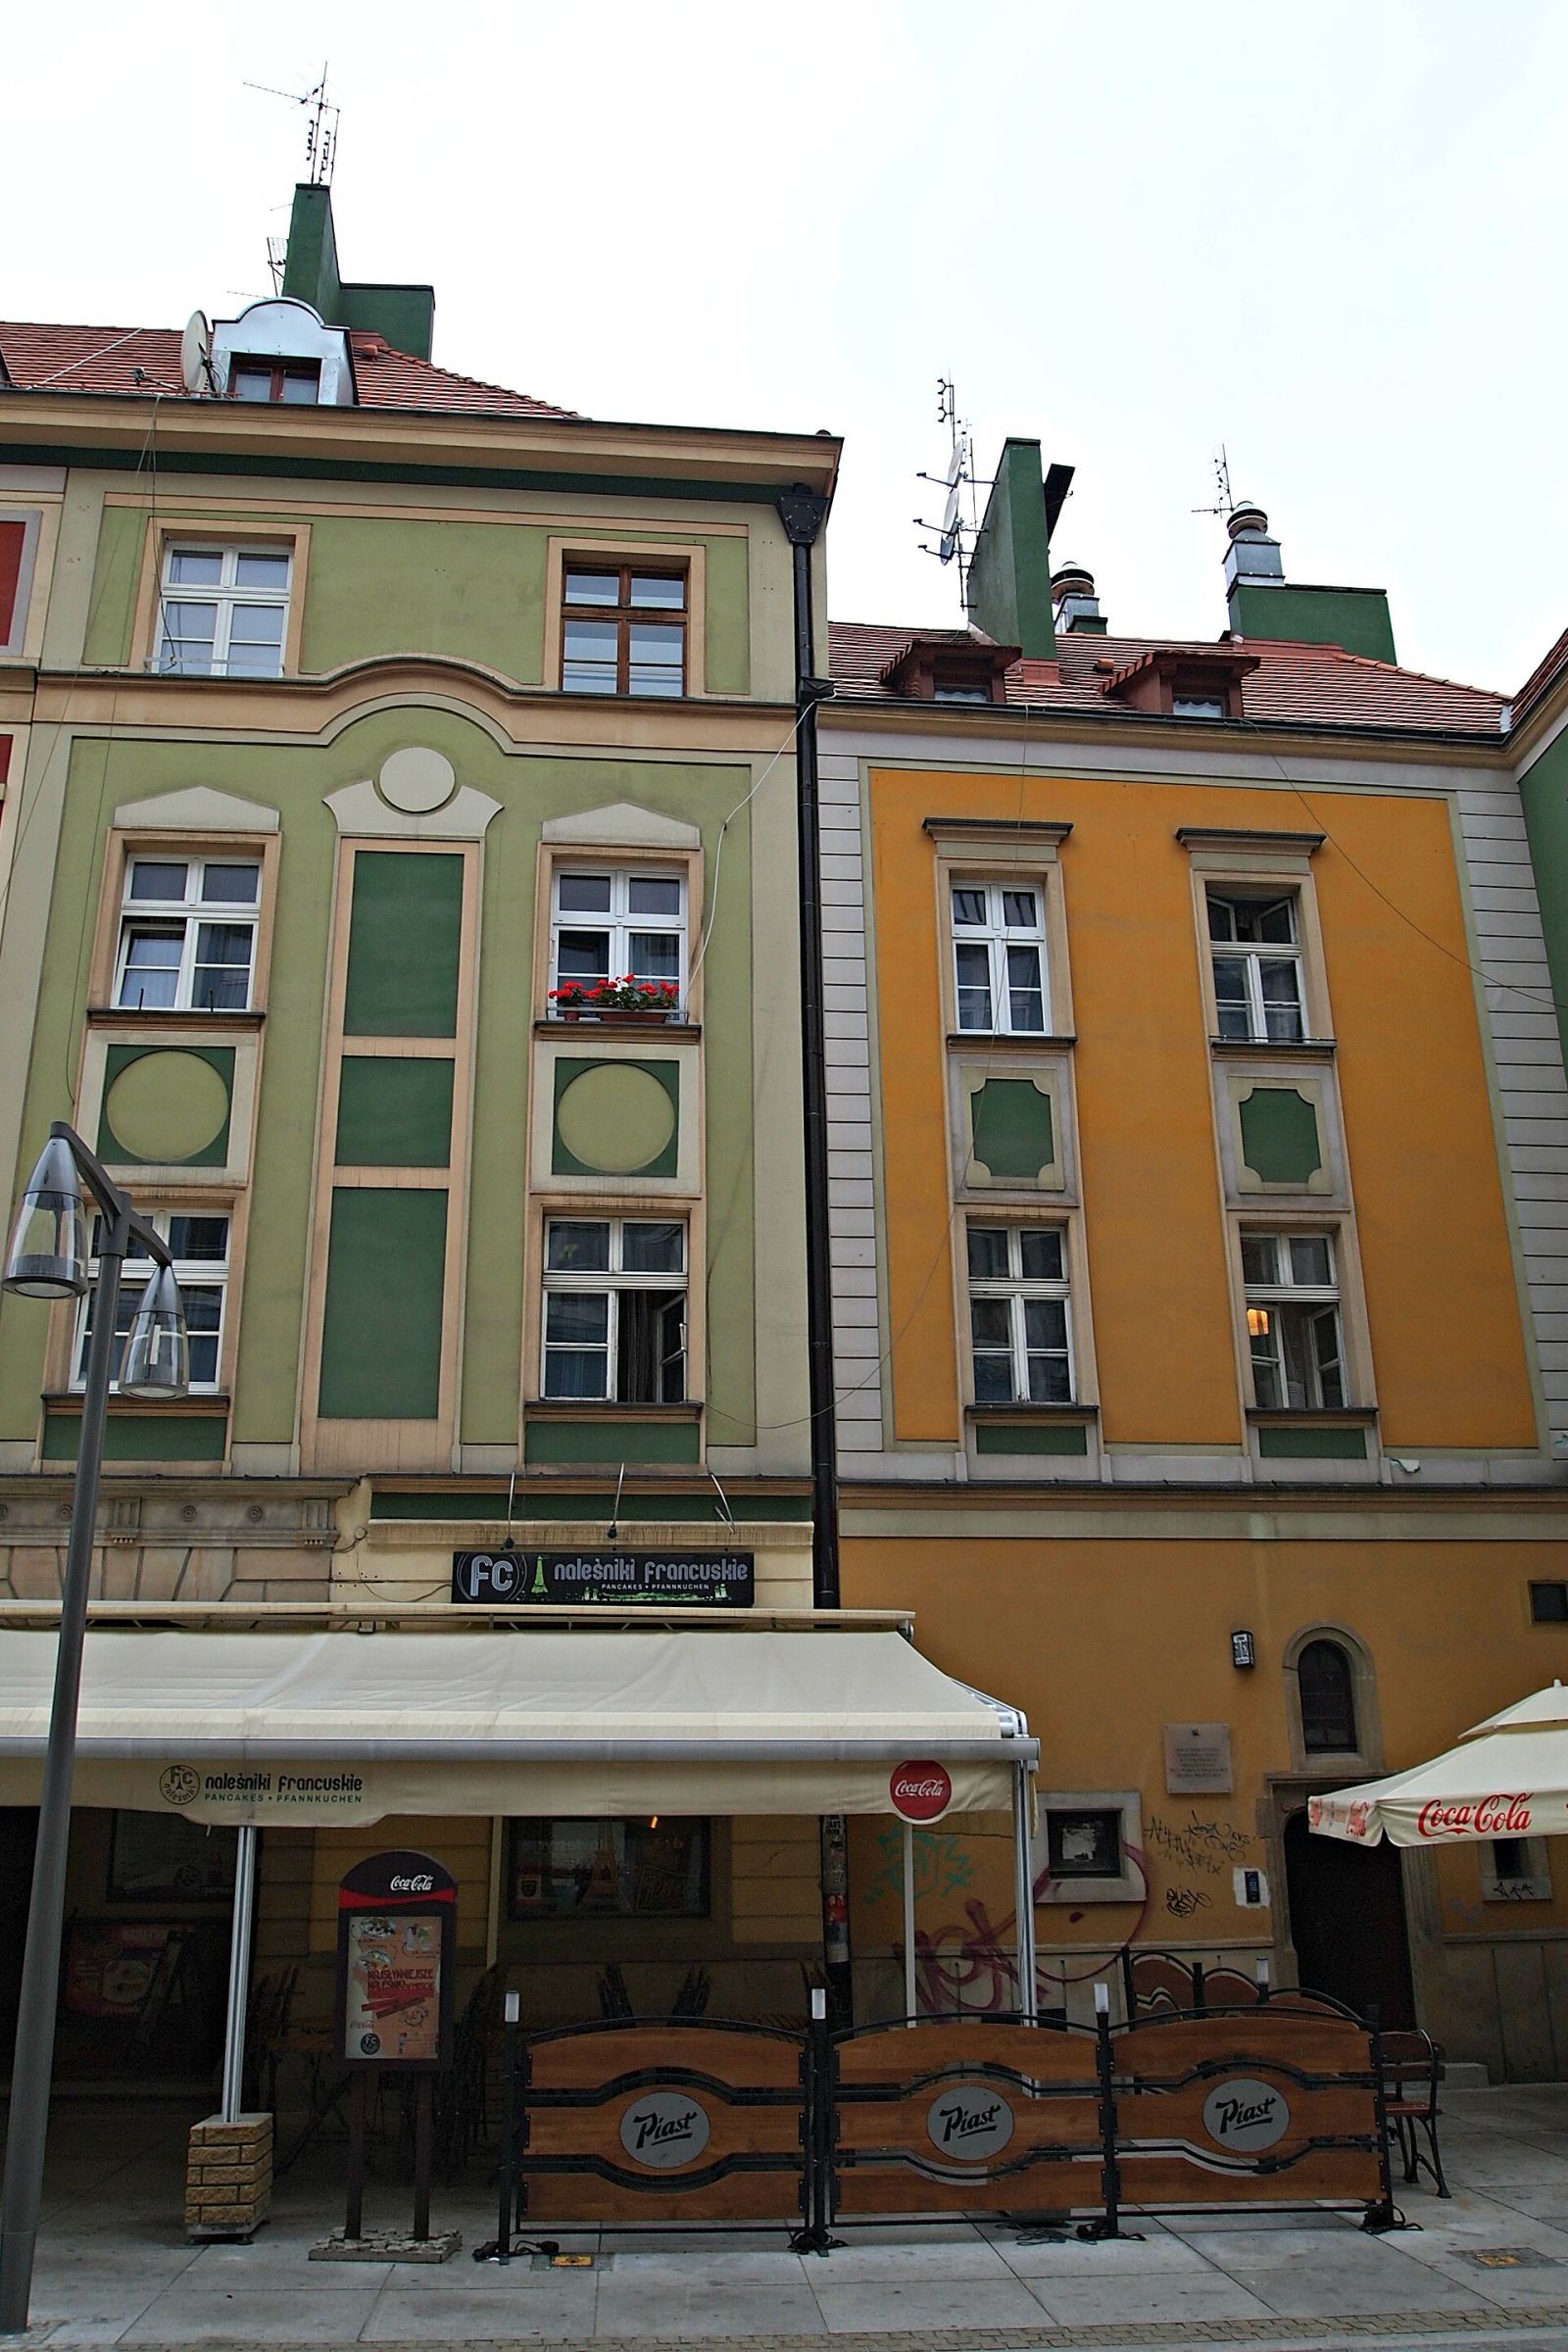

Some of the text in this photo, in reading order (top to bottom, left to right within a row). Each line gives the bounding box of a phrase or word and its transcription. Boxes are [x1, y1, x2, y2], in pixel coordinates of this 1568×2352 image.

[554, 1557, 748, 1584] naleśniki francuskie
[205, 1773, 363, 1792] naleśniki francuskie
[894, 1779, 945, 1797] Coca-Cola
[204, 1793, 363, 1803] PANCAKES PFANNKUCHEN
[1417, 1792, 1534, 1838] Coca-Cola
[390, 1874, 434, 1891] Coca-Cola
[940, 2104, 1002, 2142] Piast
[1215, 2097, 1276, 2133] Piast
[633, 2111, 697, 2149] Piast
